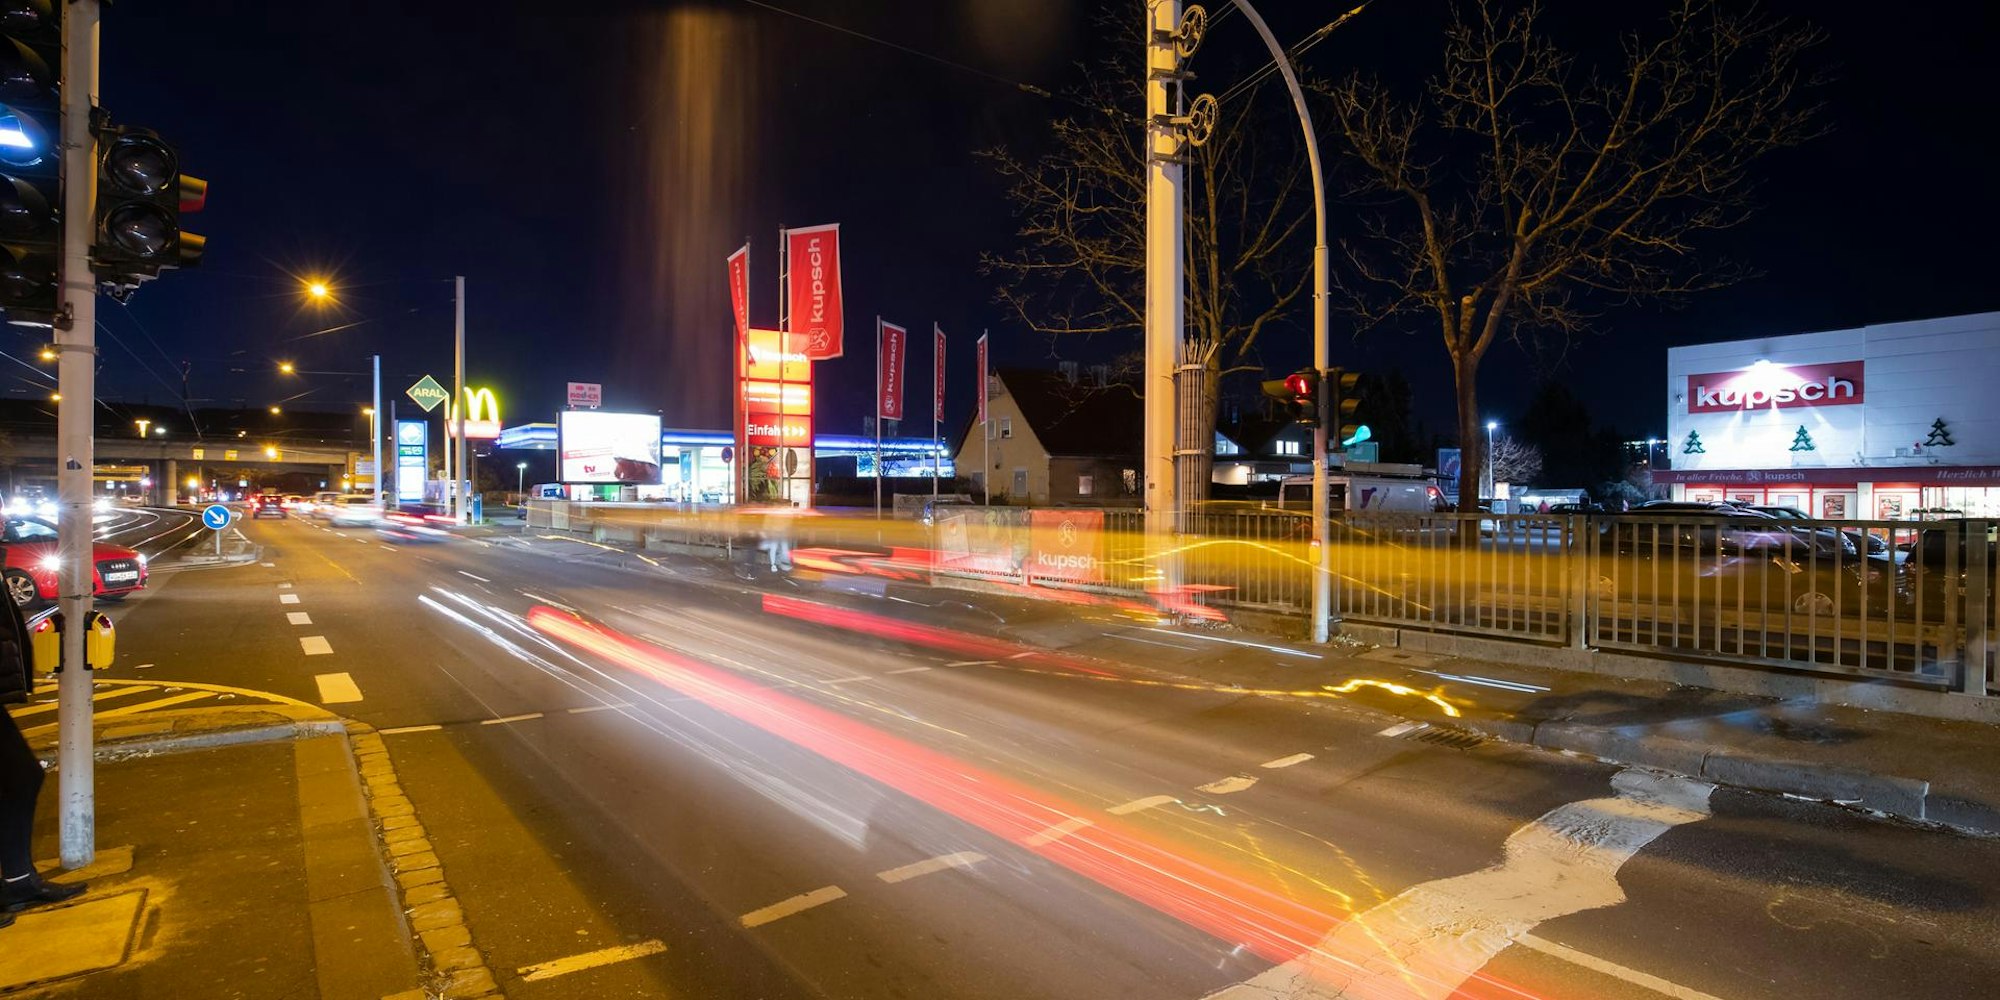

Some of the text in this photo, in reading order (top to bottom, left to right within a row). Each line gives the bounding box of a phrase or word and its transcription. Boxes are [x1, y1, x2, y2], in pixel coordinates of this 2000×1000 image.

[808, 238, 826, 323] kupsch
[413, 387, 443, 398] ARAL
[1697, 376, 1854, 409] kupsch
[748, 424, 789, 438] Einfaht
[1764, 471, 1805, 481] kupsch
[1937, 469, 1987, 479] Herzlich
[1038, 549, 1098, 570] kupsch
